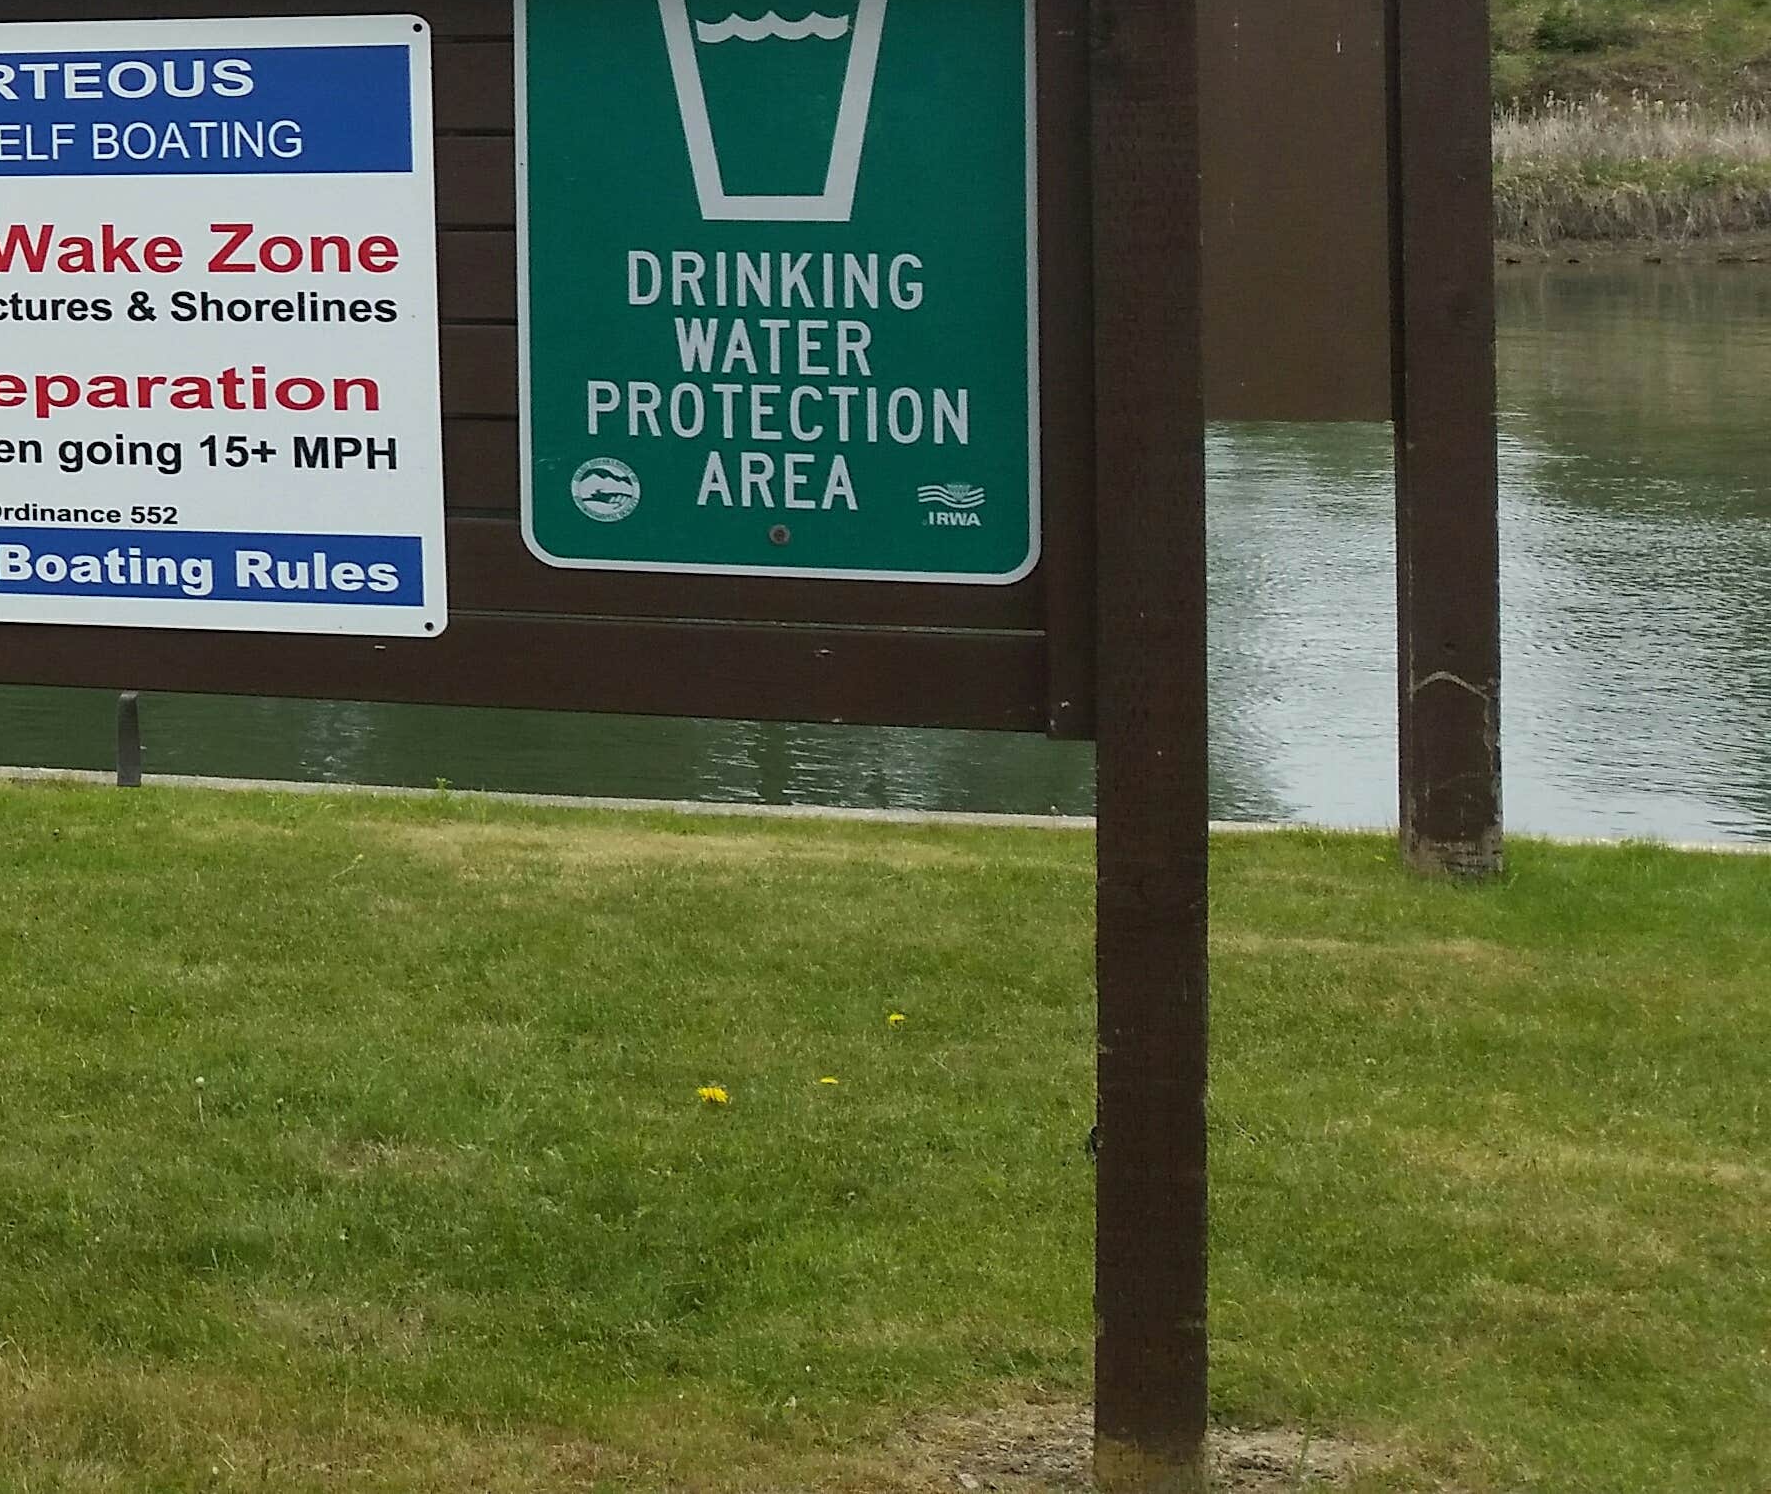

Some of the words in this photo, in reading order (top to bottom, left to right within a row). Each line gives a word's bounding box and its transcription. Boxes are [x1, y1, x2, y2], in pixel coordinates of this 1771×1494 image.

[91, 120, 303, 162] BOATING
[208, 222, 400, 274] Zone
[628, 250, 924, 309] DRINKING
[127, 292, 157, 323] &
[170, 289, 398, 325] Shorelines
[675, 318, 872, 376] WATER
[588, 380, 969, 445] PROTECTION
[58, 433, 183, 474] going
[199, 434, 277, 469] 15+
[294, 437, 398, 470] MPH
[697, 452, 859, 510] AREA
[130, 505, 178, 524] 552
[929, 511, 981, 526] IRWA
[236, 553, 399, 592] Rules
